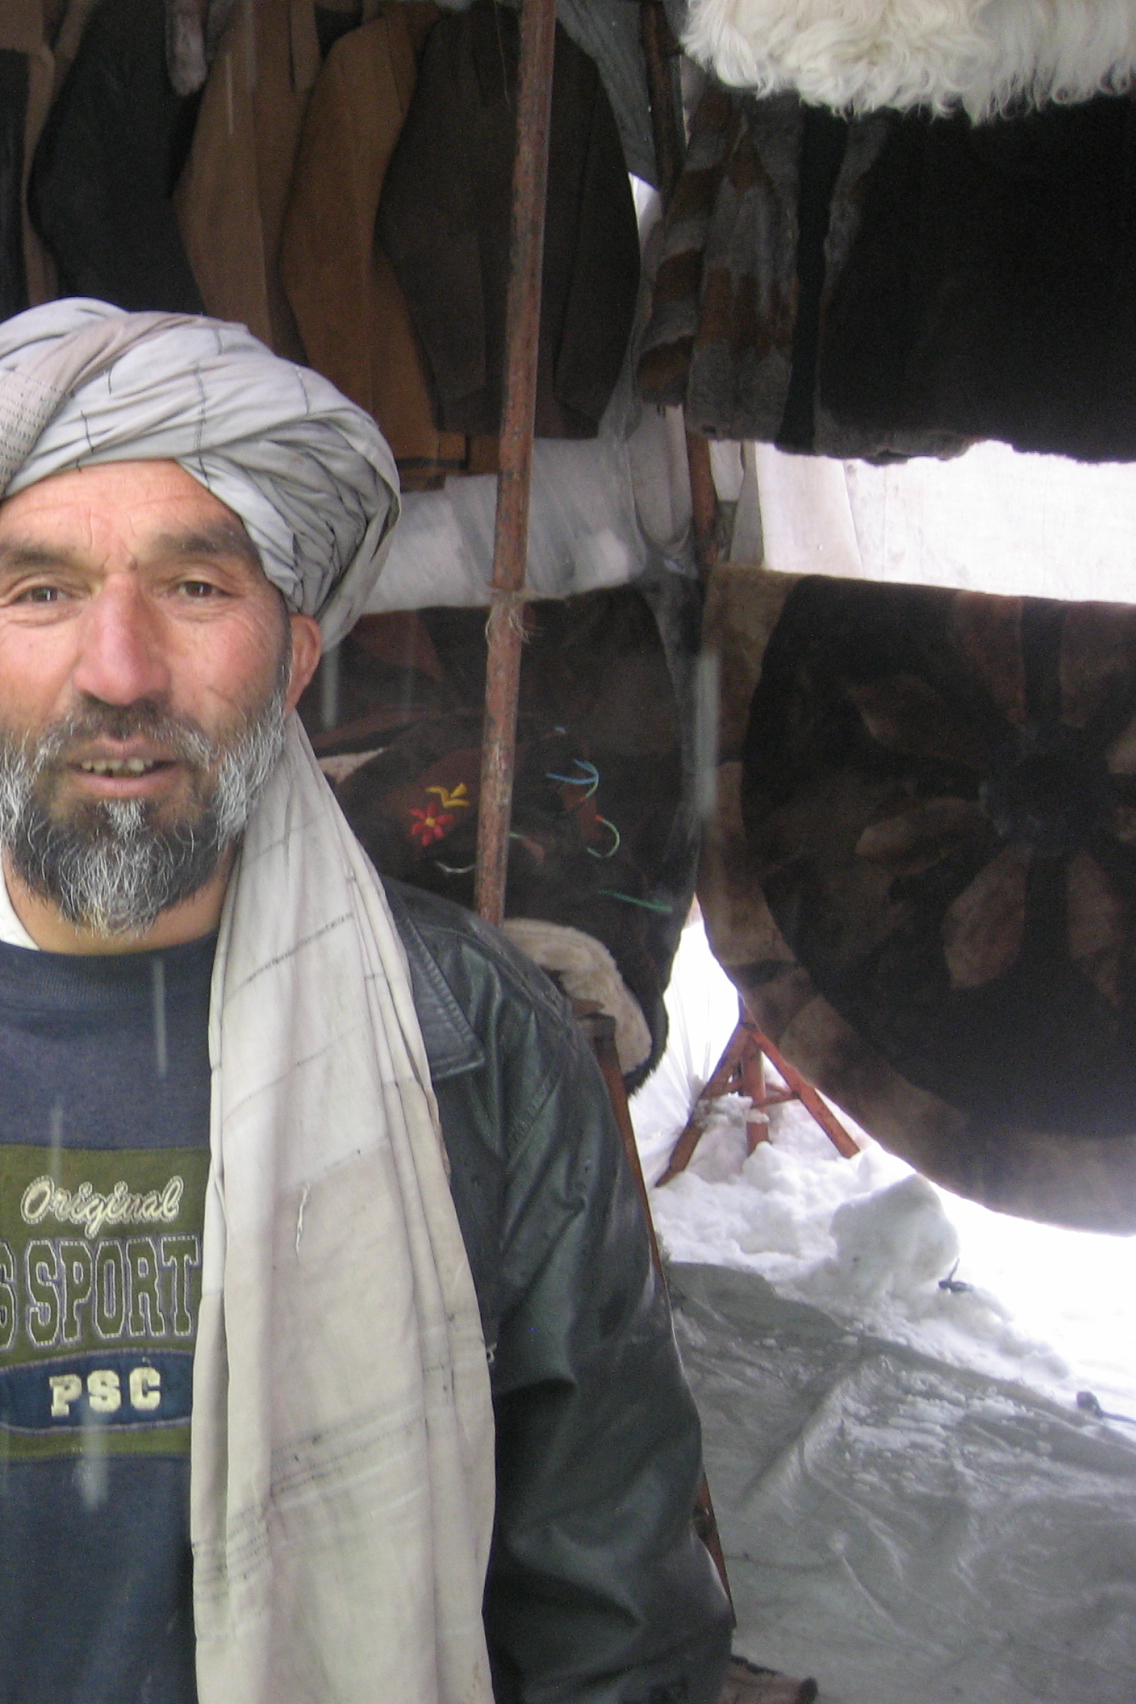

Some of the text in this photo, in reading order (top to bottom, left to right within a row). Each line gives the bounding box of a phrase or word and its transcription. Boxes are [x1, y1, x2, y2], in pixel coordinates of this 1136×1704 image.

[20, 1174, 185, 1239] Original
[24, 1233, 202, 1350] SPORT
[49, 1366, 162, 1418] PSC
